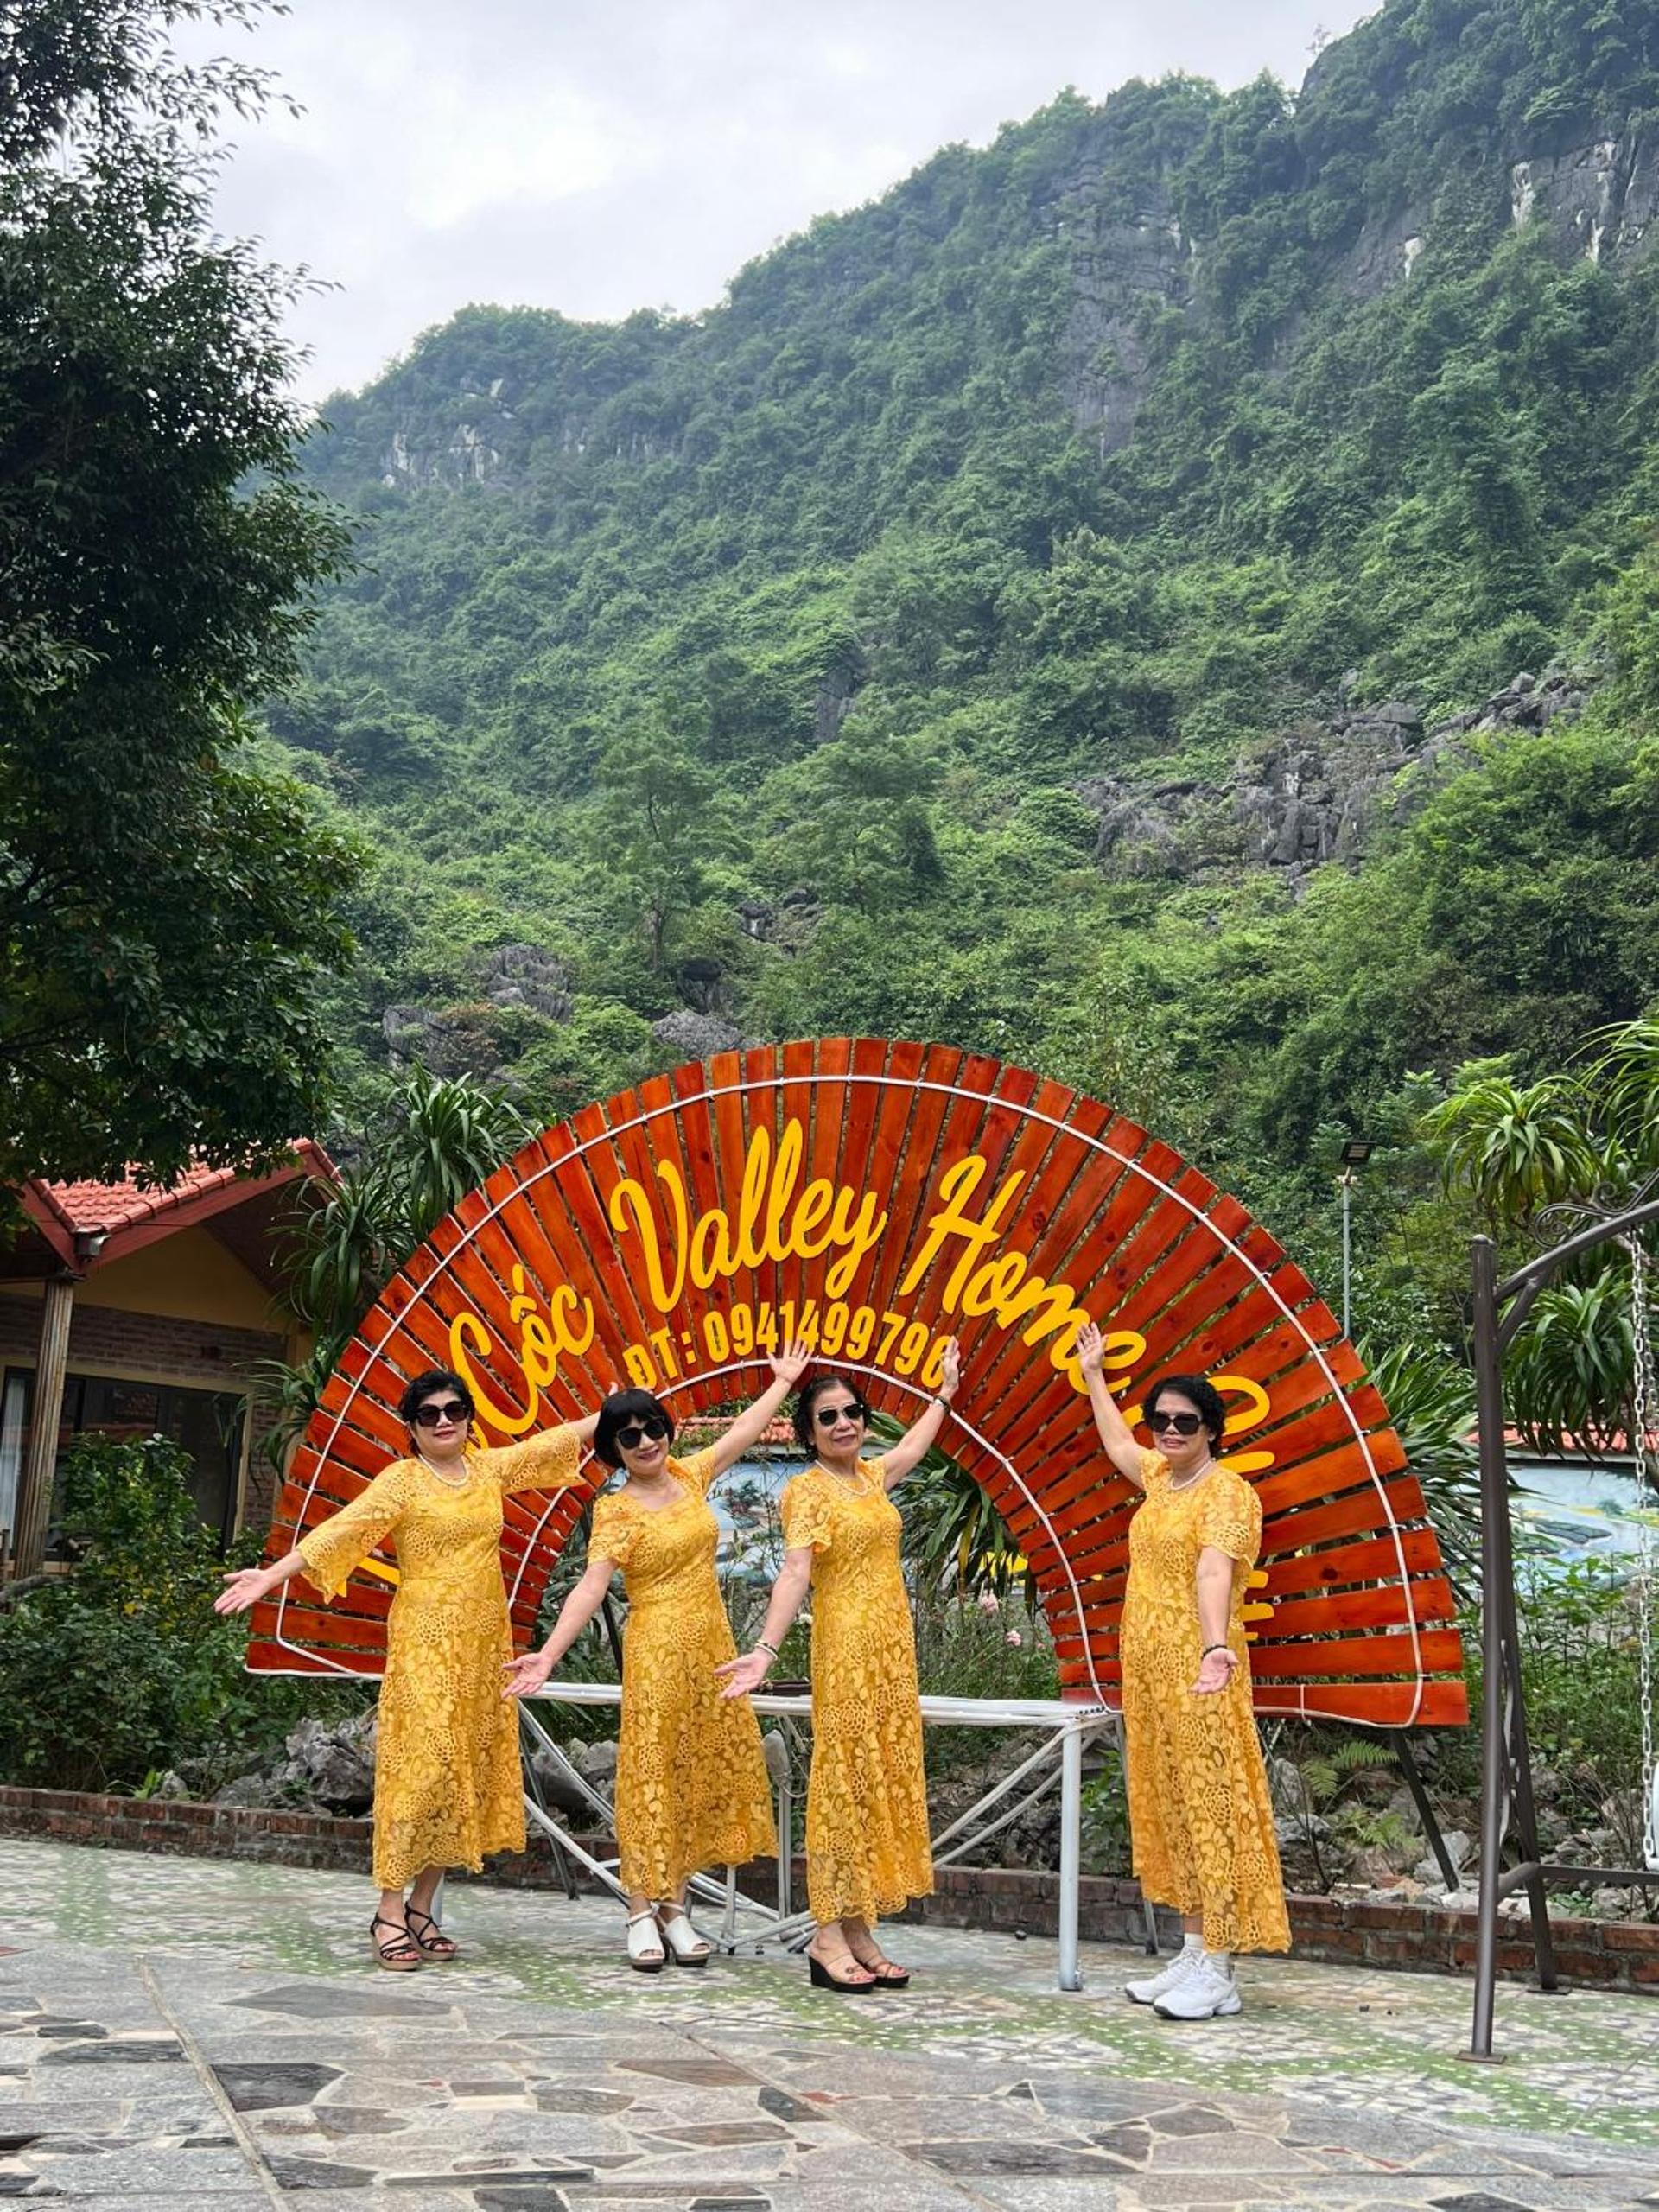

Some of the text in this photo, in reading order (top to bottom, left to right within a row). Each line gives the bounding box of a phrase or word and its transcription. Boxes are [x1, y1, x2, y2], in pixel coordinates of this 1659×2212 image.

[449, 1118, 1146, 1434] Cốc Valley Home
